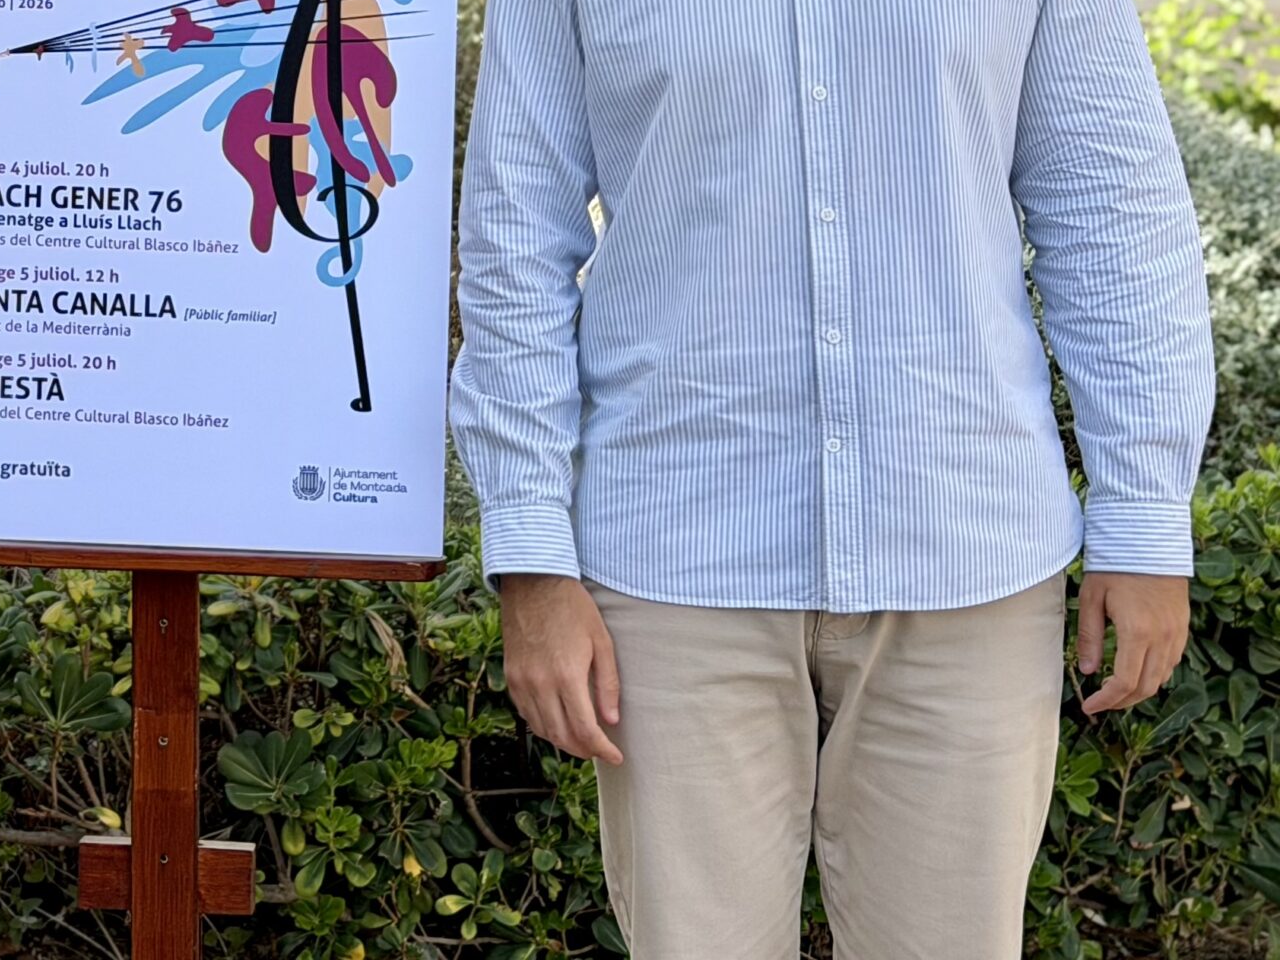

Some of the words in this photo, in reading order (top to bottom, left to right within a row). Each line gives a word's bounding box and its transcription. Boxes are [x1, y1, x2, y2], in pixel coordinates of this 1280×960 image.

[10, 162, 20, 175] 4
[23, 161, 70, 178] juliol.
[76, 164, 95, 176] 20
[100, 163, 109, 177] h
[51, 186, 139, 211] GENER
[149, 190, 182, 213] 76
[59, 217, 68, 227] a
[73, 213, 112, 229] Lluís
[118, 215, 161, 231] Llach
[10, 233, 31, 246] del
[36, 234, 81, 248] Centre
[85, 236, 140, 250] Cultural
[144, 238, 188, 252] Blasco
[193, 240, 239, 253] Ibáñez
[20, 267, 29, 280] 5
[32, 266, 80, 283] juliol.
[86, 270, 104, 282] 12
[110, 269, 119, 283] h
[52, 291, 176, 318] CANALLA
[184, 308, 224, 321] [Públic
[225, 310, 277, 324] familiar]
[5, 319, 22, 332] de
[26, 320, 38, 333] la
[43, 321, 131, 337] Mediterrània
[17, 354, 26, 367] 5
[29, 353, 77, 370] juliol.
[83, 356, 102, 369] 20
[107, 356, 116, 370] h
[0, 406, 21, 419] del
[25, 407, 71, 421] Centre
[75, 409, 130, 424] Cultural
[134, 411, 178, 426] Blasco
[183, 413, 229, 427] Ibáñez
[0, 461, 70, 479] gratuïta
[333, 468, 398, 481] Ajuntament
[333, 480, 347, 490] de
[350, 481, 407, 493] Montcada
[333, 492, 378, 503] Cultura
